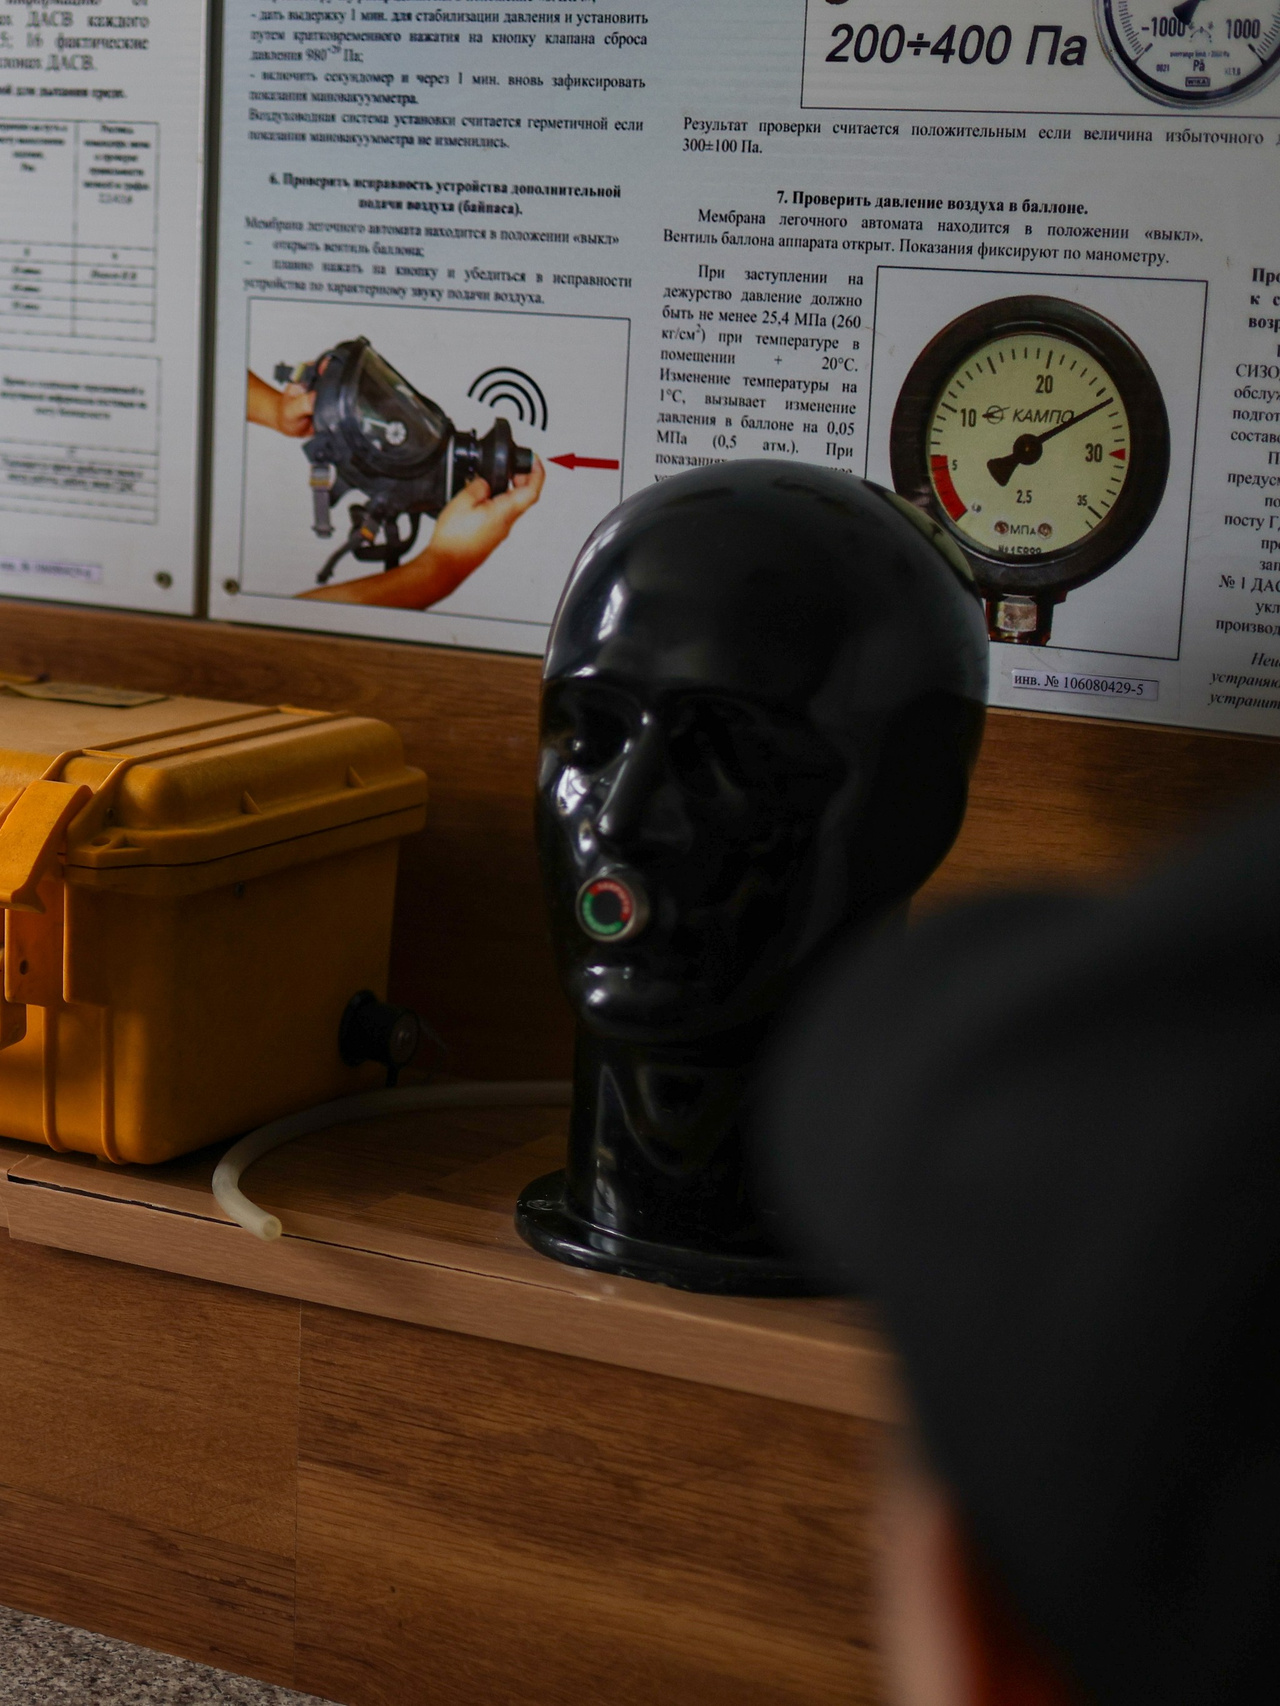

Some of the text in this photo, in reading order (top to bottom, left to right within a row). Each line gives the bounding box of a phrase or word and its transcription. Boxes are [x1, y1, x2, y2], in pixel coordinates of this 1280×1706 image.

[415, 9, 499, 23] стабилизации
[503, 12, 560, 24] давления
[564, 13, 572, 23] и
[576, 13, 648, 26] установить
[1226, 18, 1261, 39] 1000
[469, 32, 483, 43] на
[491, 33, 536, 47] кнопку
[545, 34, 595, 45] клапана
[604, 32, 647, 49] сброса
[825, 24, 1087, 65] 200÷400 Па
[401, 73, 409, 83] и
[416, 74, 449, 89] через
[458, 72, 463, 84] 1
[472, 75, 500, 86] мин.
[508, 75, 544, 86] вновь
[551, 74, 646, 91] зафиксировать
[461, 117, 521, 128] считается
[527, 117, 608, 132] герметичной
[614, 120, 643, 131] если
[683, 116, 1264, 145] Результат проверки считается положительным если величина избыточного
[682, 138, 763, 154] 300±100 Па.
[436, 180, 507, 195] устройства
[510, 185, 621, 199] дополнительной
[458, 199, 523, 216] (байпаса).
[777, 190, 1088, 215] 7. Проверить давление воздуха в баллоне.
[698, 209, 1203, 242] Мембрана легочного автомата находится в положении «выкл».
[489, 230, 497, 240] в
[500, 230, 569, 243] положении
[573, 233, 619, 245] «выкл»
[663, 229, 1169, 267] Вентиль баллона аппарата открыт. Показания фиксируют по манометру.
[464, 266, 526, 283] убедиться
[536, 272, 543, 283] в
[553, 274, 632, 288] исправности
[698, 264, 864, 286] При заступлении на
[662, 286, 862, 307] дежурство давление должно
[1250, 295, 1260, 306] к
[662, 305, 861, 330] быть не менее 25,4 МПа (260
[718, 331, 742, 346] при
[755, 333, 839, 351] температуре
[853, 339, 860, 350] в
[660, 349, 735, 365] помещении
[660, 368, 857, 394] Изменение температуры на
[1035, 374, 1053, 394] 20
[705, 394, 766, 409] вызывает
[785, 399, 856, 414] изменение
[656, 411, 855, 437] давления в баллоне на 0,05
[961, 408, 1074, 427] 10 КАМПО
[656, 430, 853, 460] МПа (0,5 атм.). При
[1084, 443, 1103, 463] 30
[952, 459, 958, 471] 5
[1077, 495, 1088, 507] 35
[1224, 515, 1265, 531] посту
[1218, 574, 1245, 589] № 1
[1014, 675, 1143, 696] инв. № 106080429-5
